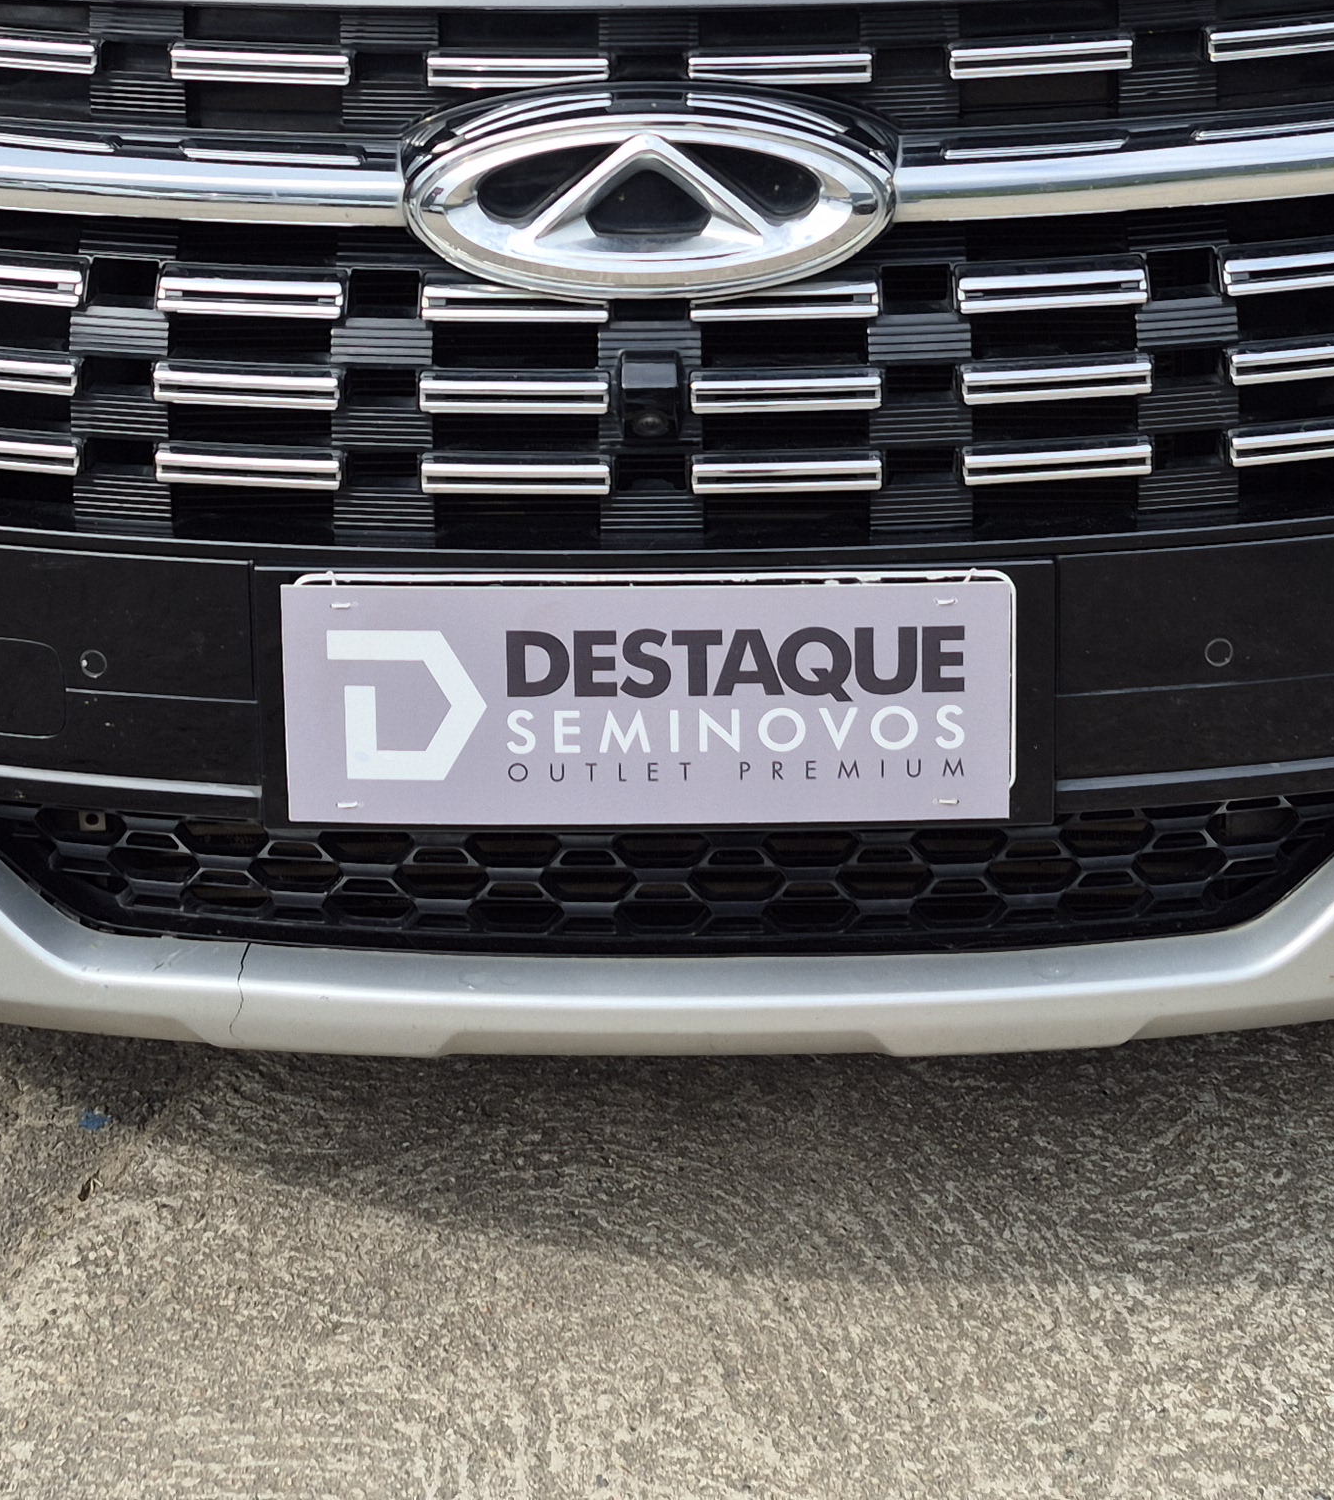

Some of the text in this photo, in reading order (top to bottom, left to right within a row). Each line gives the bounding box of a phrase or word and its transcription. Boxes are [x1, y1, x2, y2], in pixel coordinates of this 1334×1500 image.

[505, 625, 966, 703] DESTAQUE
[505, 704, 966, 755] SEMINOVOS
[507, 758, 965, 783] OUTLET PREMIUM
